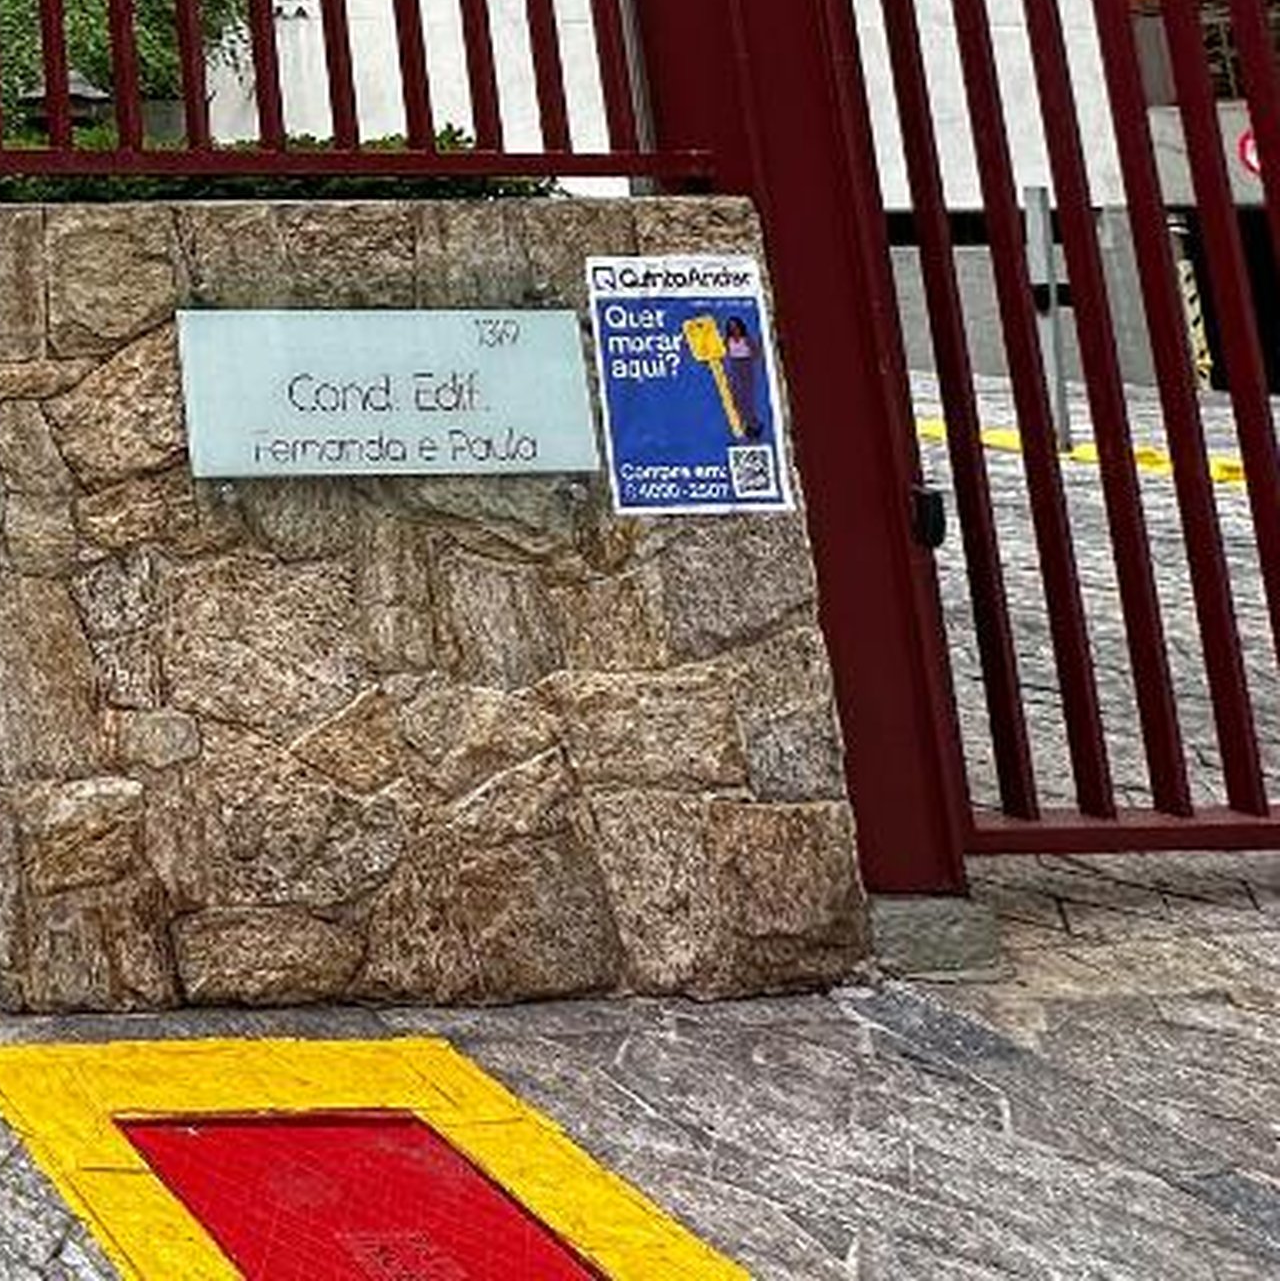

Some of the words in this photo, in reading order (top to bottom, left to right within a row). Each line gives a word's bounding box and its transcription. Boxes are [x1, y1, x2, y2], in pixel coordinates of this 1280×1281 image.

[604, 305, 666, 329] Quer
[607, 331, 684, 354] morar
[611, 353, 682, 383] aqui?
[287, 373, 401, 413] Cond.
[412, 372, 492, 413] Edif.
[251, 428, 408, 464] Fernanda
[417, 435, 439, 462] e
[447, 428, 538, 462] Paula
